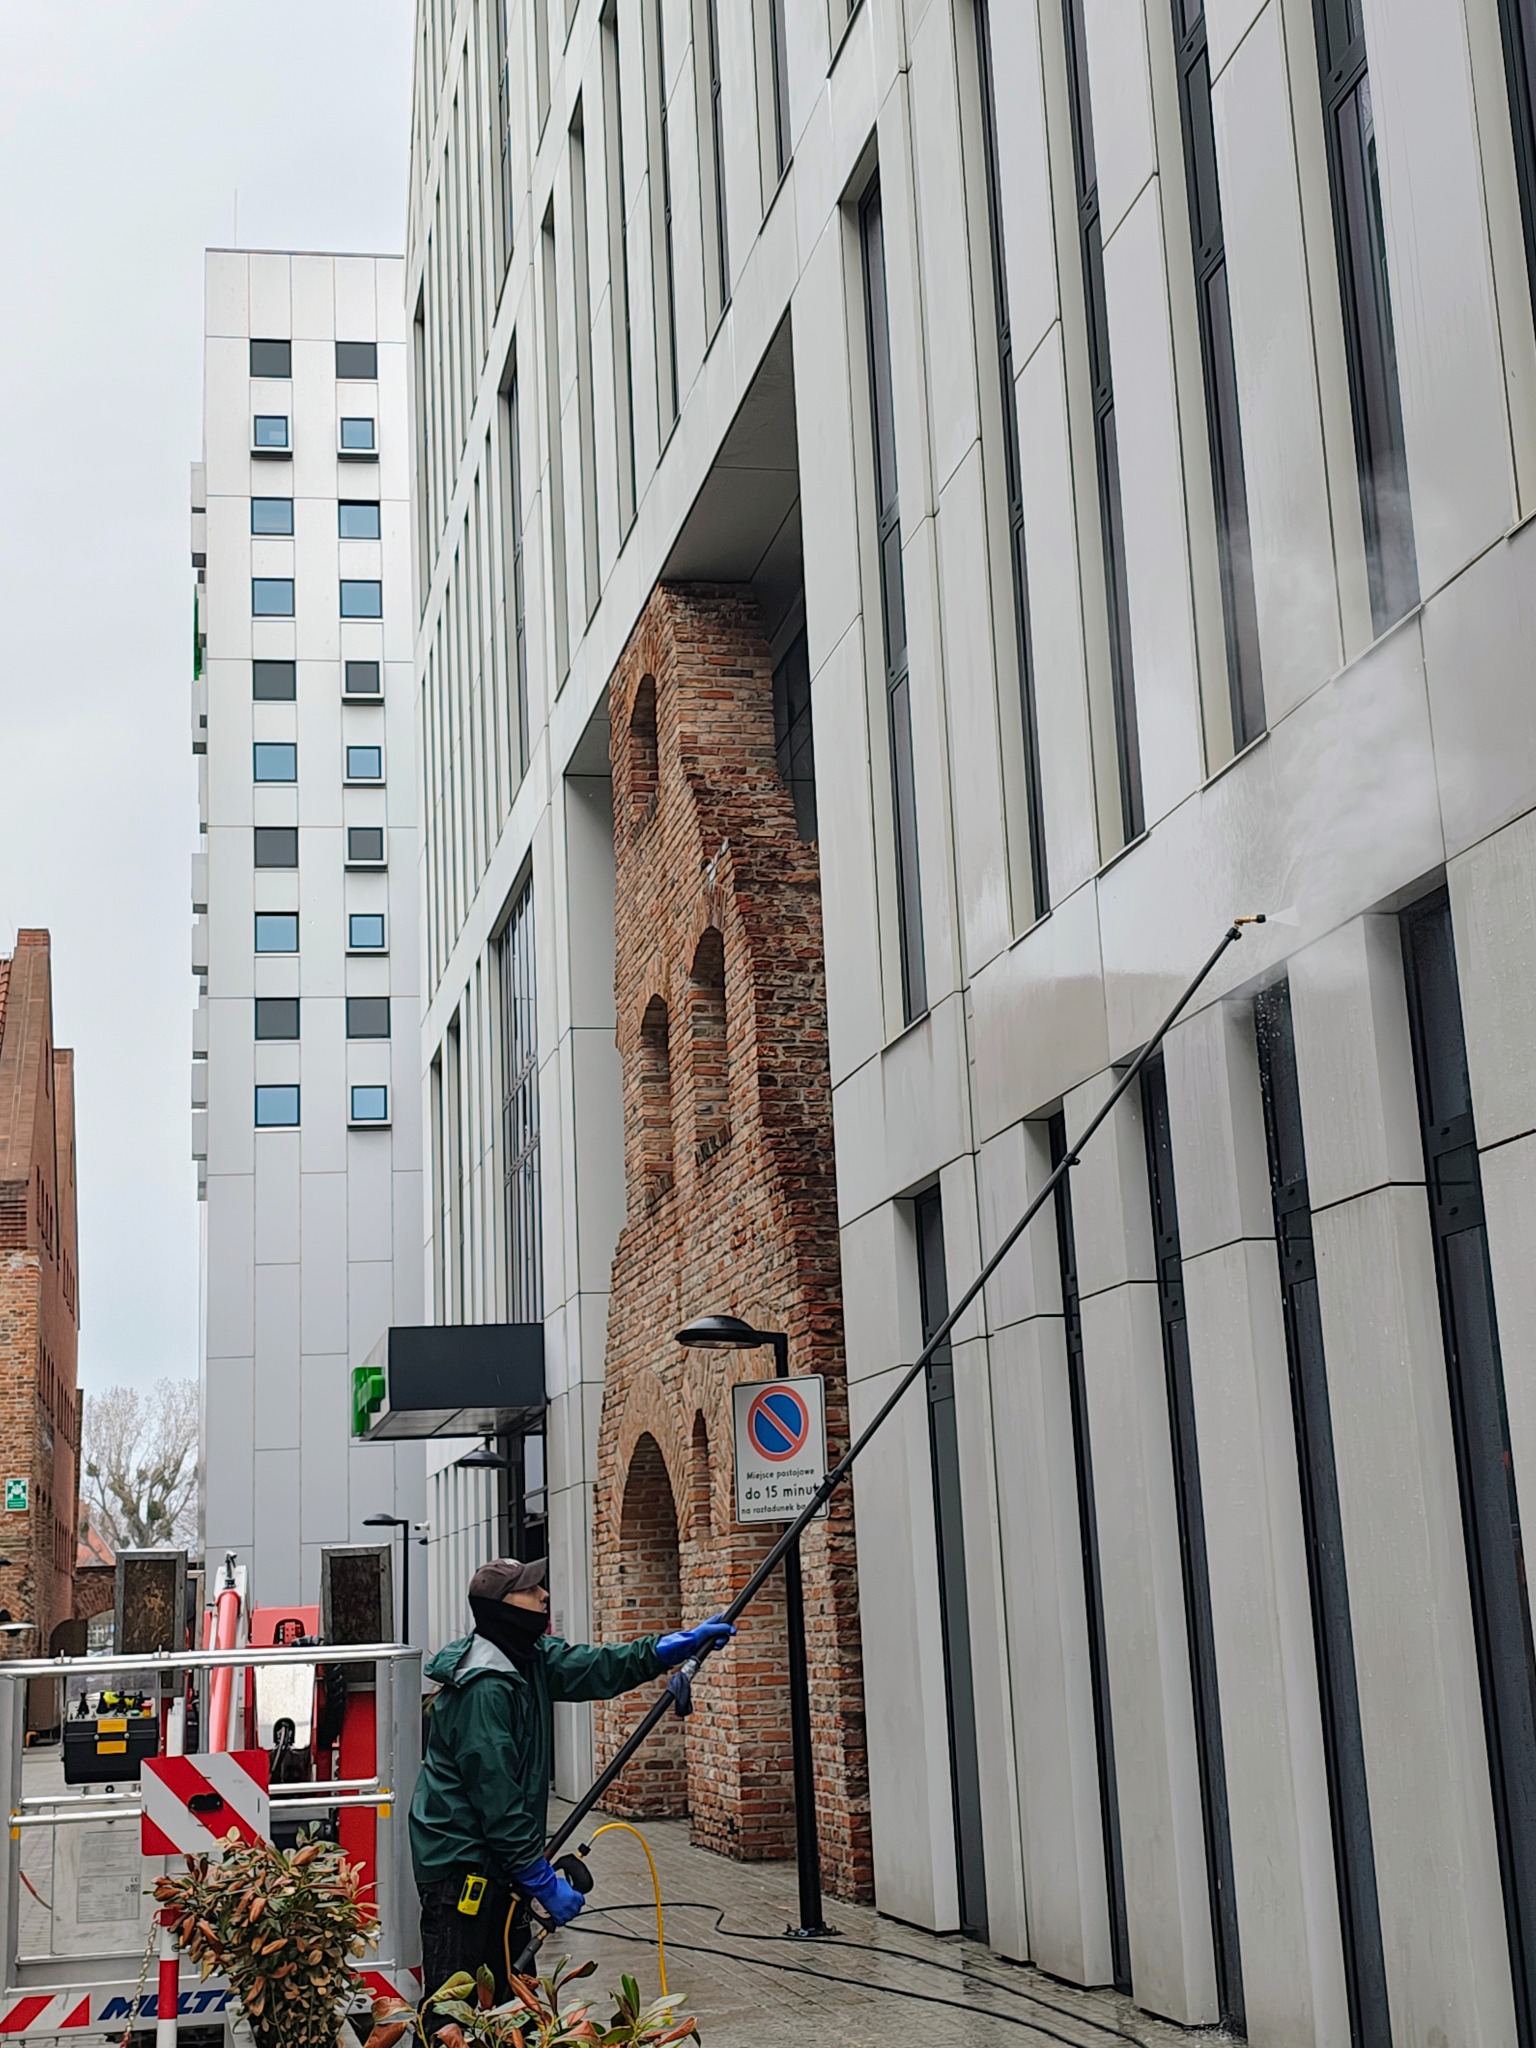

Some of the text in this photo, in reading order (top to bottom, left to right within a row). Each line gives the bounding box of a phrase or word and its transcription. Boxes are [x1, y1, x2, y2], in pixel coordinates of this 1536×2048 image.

[747, 1468, 814, 1480] Miejsce postojowe
[745, 1487, 761, 1500] do
[765, 1485, 778, 1498] 15
